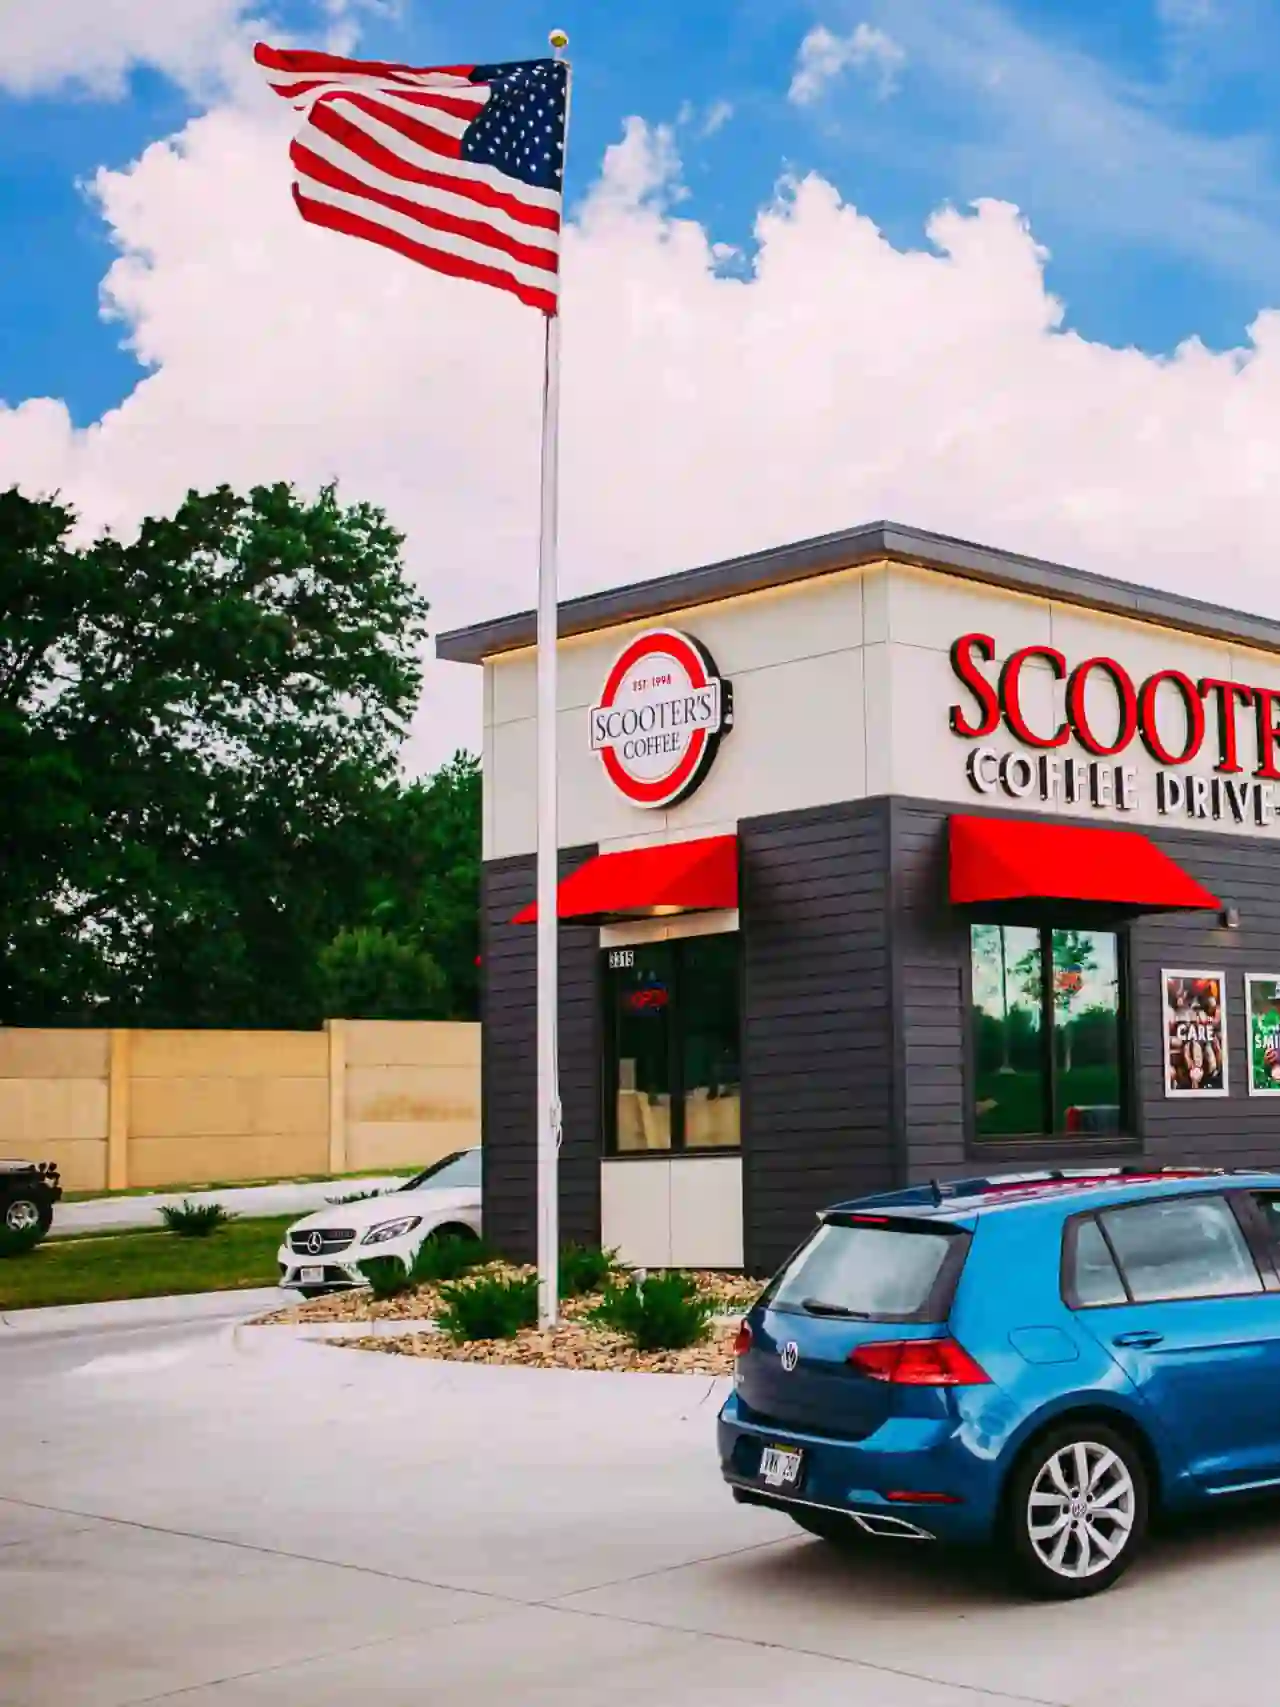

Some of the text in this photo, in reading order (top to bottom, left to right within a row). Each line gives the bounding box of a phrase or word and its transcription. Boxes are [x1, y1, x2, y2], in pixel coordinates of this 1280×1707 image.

[595, 693, 711, 742] SCOOTER'S
[623, 732, 681, 760] COFFEE
[966, 747, 1139, 811] COFFEE
[1176, 1022, 1215, 1042] CARE
